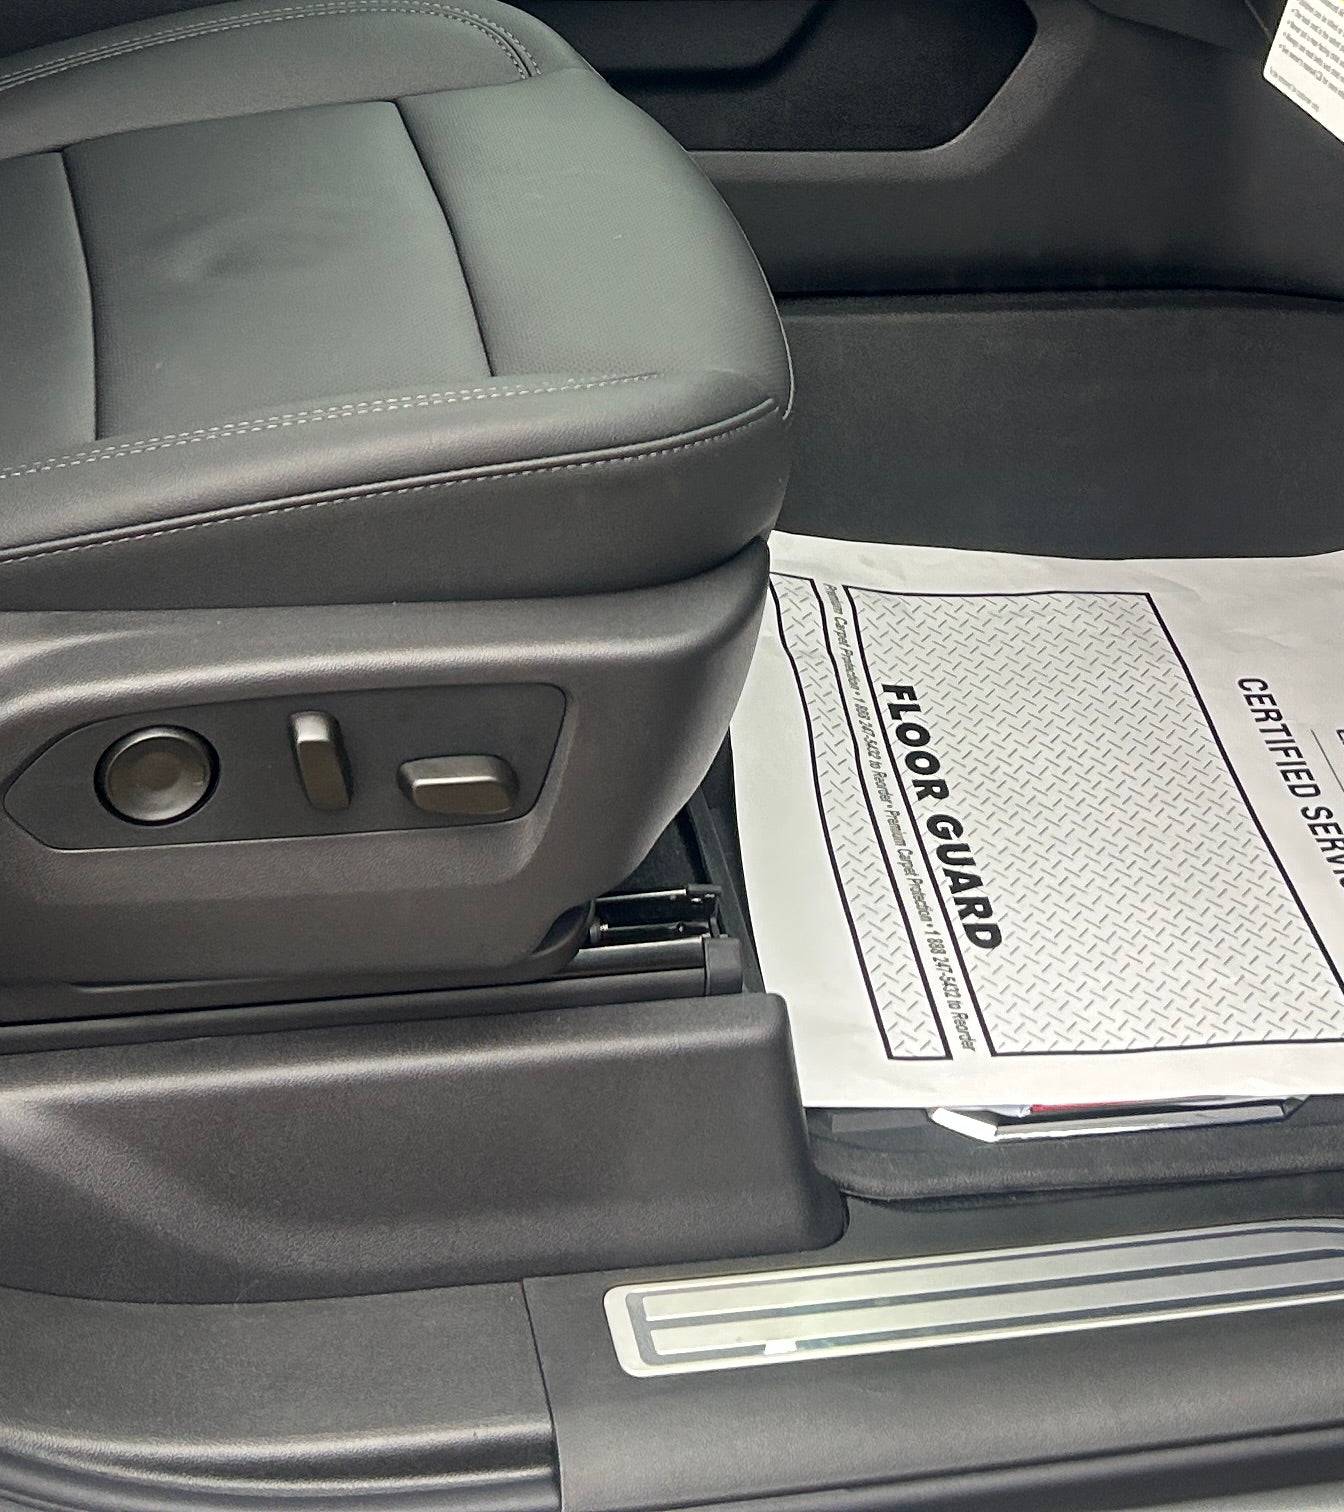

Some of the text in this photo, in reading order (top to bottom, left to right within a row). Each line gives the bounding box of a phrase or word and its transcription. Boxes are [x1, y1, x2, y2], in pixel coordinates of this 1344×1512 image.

[835, 617, 849, 647] Carpet
[842, 648, 859, 690] Protection
[1238, 677, 1321, 799] CERTIFIED
[874, 771, 892, 803] Reorder
[881, 684, 1003, 950] FLOOR GUARD
[887, 811, 906, 846] Premium
[898, 849, 917, 876] Carpet
[908, 878, 932, 921] Protection
[927, 939, 946, 954] 888
[933, 957, 961, 997] 247-5432
[952, 1012, 976, 1052] Reorder
